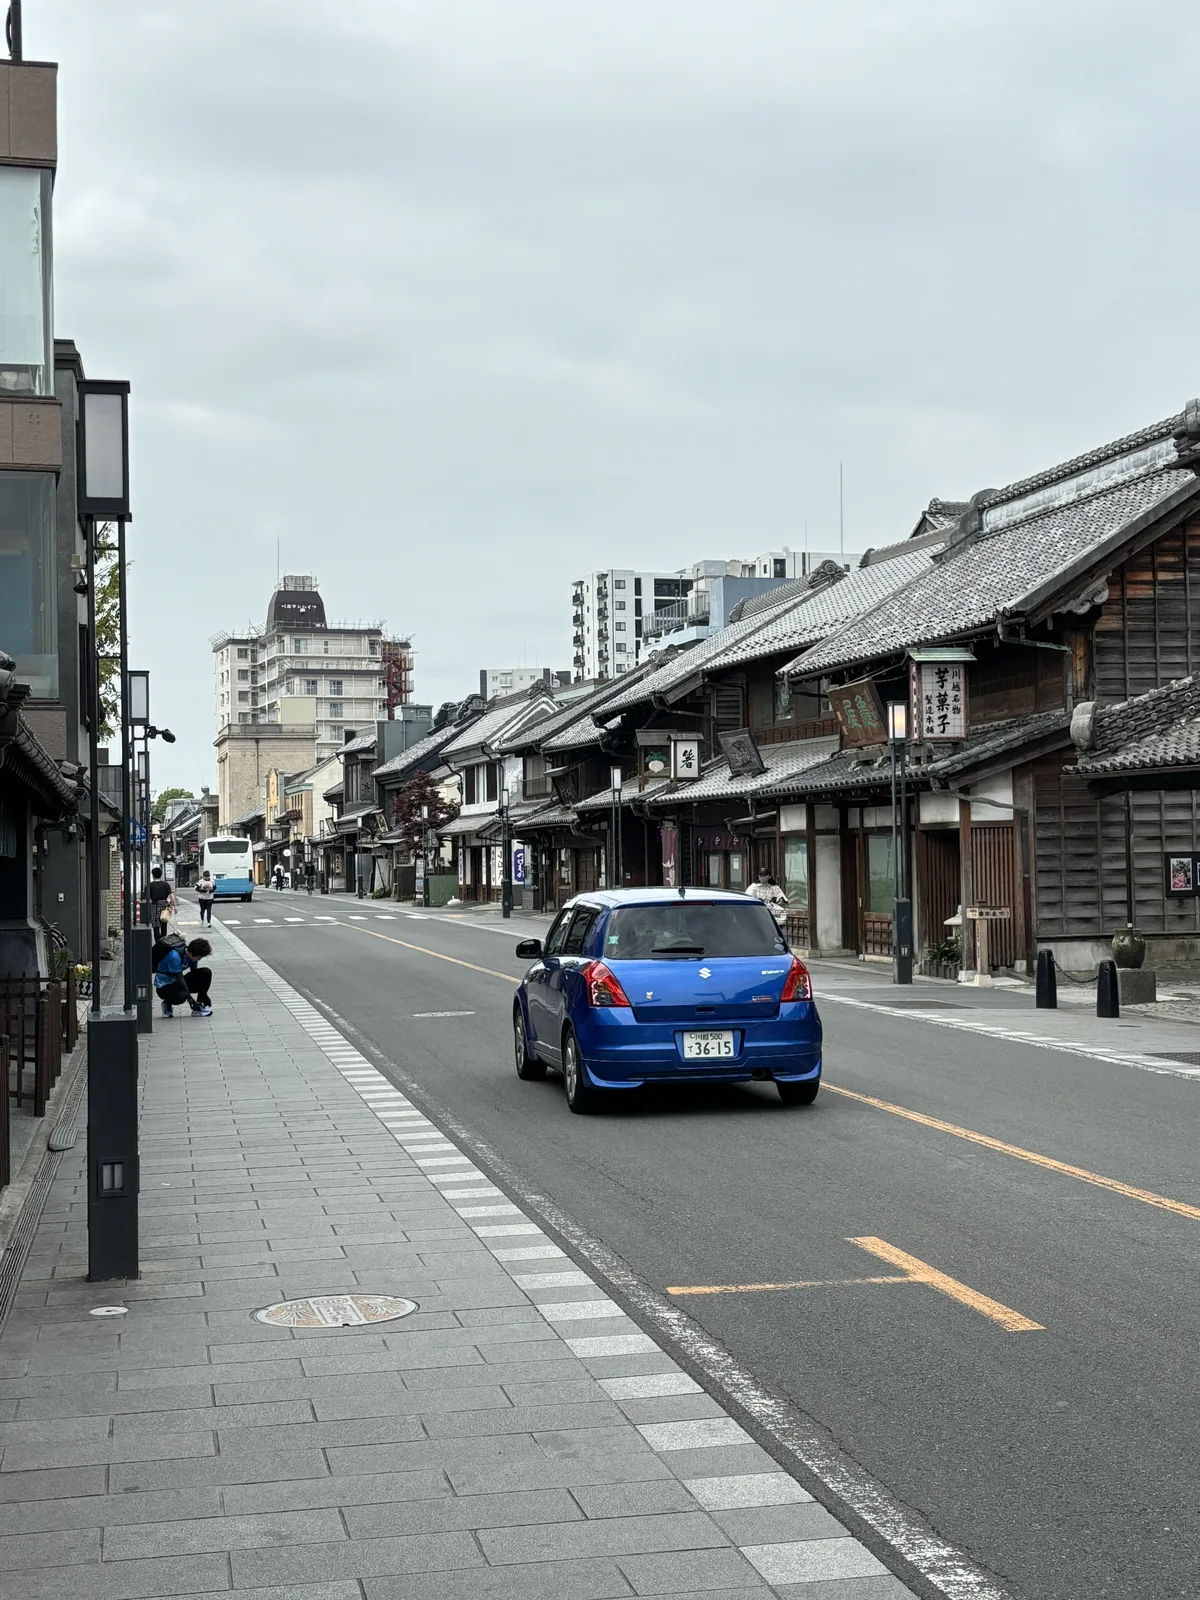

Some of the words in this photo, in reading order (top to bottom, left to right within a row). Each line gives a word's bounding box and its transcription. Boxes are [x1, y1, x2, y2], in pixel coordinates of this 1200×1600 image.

[934, 667, 951, 734] 芋菓子
[951, 669, 961, 716] 川越名物
[679, 748, 696, 769] 箸
[709, 1033, 723, 1041] 500
[687, 1045, 694, 1053] て
[694, 1040, 731, 1056] 36-15
